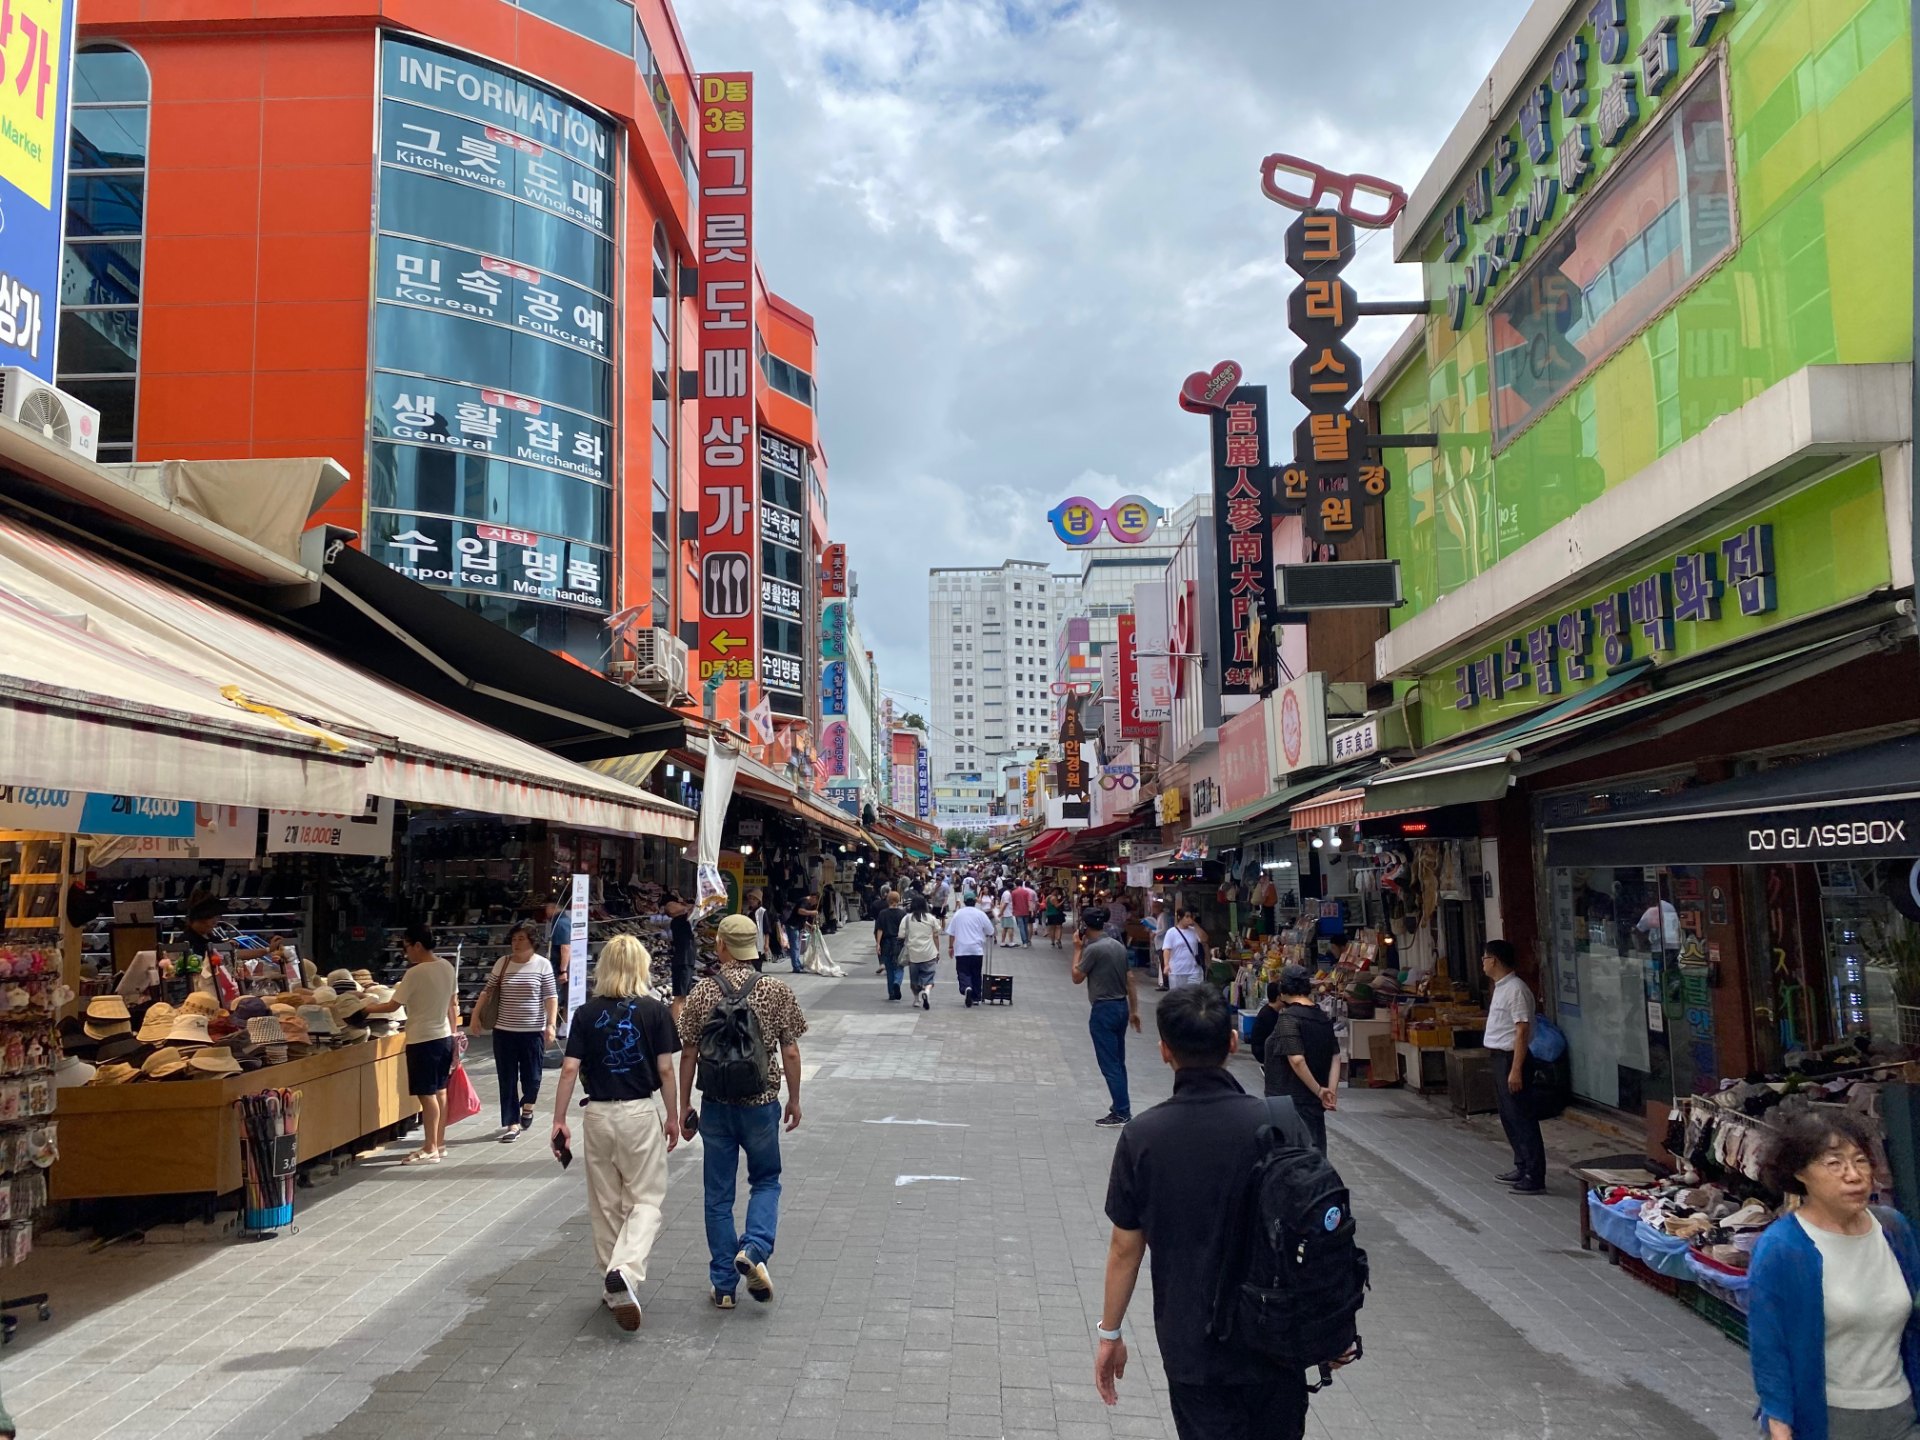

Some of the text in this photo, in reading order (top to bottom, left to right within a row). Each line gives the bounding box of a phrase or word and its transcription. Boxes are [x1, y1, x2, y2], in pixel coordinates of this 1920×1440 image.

[399, 56, 606, 160] INFORMATION
[703, 78, 748, 103] D동
[1, 114, 43, 163] Market
[704, 107, 746, 133] 3층
[396, 122, 604, 219] 그릇 도매
[396, 149, 604, 229] Kitchenware Wholesale
[396, 254, 604, 341] 민속 공예
[395, 287, 605, 354] Korean Folkcraft
[1302, 216, 1351, 462] 크리스탈
[1203, 371, 1236, 401] Ginseng
[1206, 364, 1235, 390] Korean
[392, 393, 604, 466] 생활 잡화
[761, 435, 799, 468] 그릇도매
[392, 426, 602, 479] General Merchandise
[488, 528, 532, 545] 지하
[761, 506, 801, 538] 민속공예
[1067, 509, 1144, 532] 남도
[388, 529, 602, 592] 수입 명품
[831, 545, 845, 594] 그릇도매
[389, 562, 603, 607] Imported Merchandise
[762, 581, 801, 610] 생활잡화
[1455, 525, 1776, 711] 크리스탈안경백화점
[762, 655, 801, 682] 수입명품
[833, 662, 845, 713] 생활잡화
[833, 724, 846, 775] 수입명품
[1065, 740, 1081, 788] 안경원
[1336, 727, 1374, 759] 東京食品
[136, 797, 180, 819] 14,000
[827, 788, 857, 802] 명품
[285, 825, 342, 847] 2개 18,000원
[1781, 819, 1906, 850] GLASSBOX
